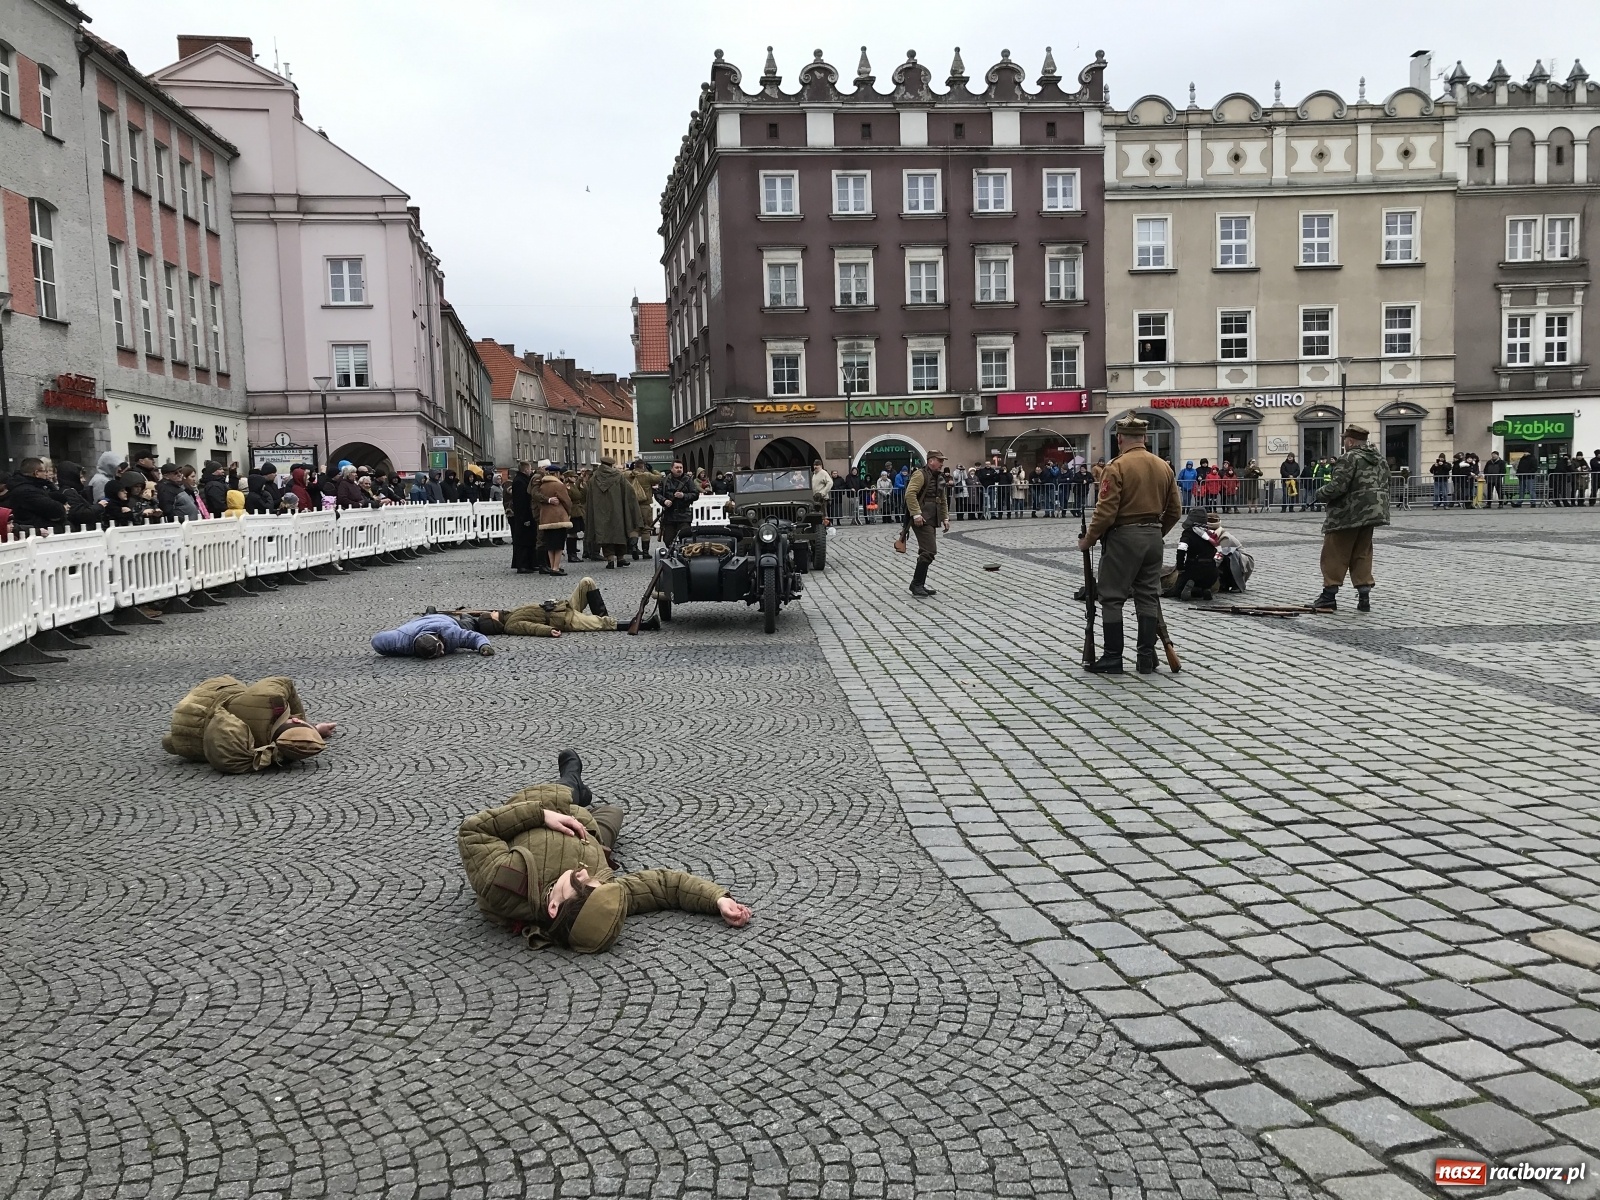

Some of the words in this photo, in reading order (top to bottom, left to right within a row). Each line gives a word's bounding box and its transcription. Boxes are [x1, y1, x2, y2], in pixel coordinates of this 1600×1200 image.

[1150, 396, 1230, 409] RESTAURACJA
[1254, 392, 1305, 409] SHIRO
[753, 403, 816, 414] TABAC
[845, 399, 935, 418] KANTOR
[1514, 420, 1565, 434] żabka
[873, 445, 906, 453] KANTOR
